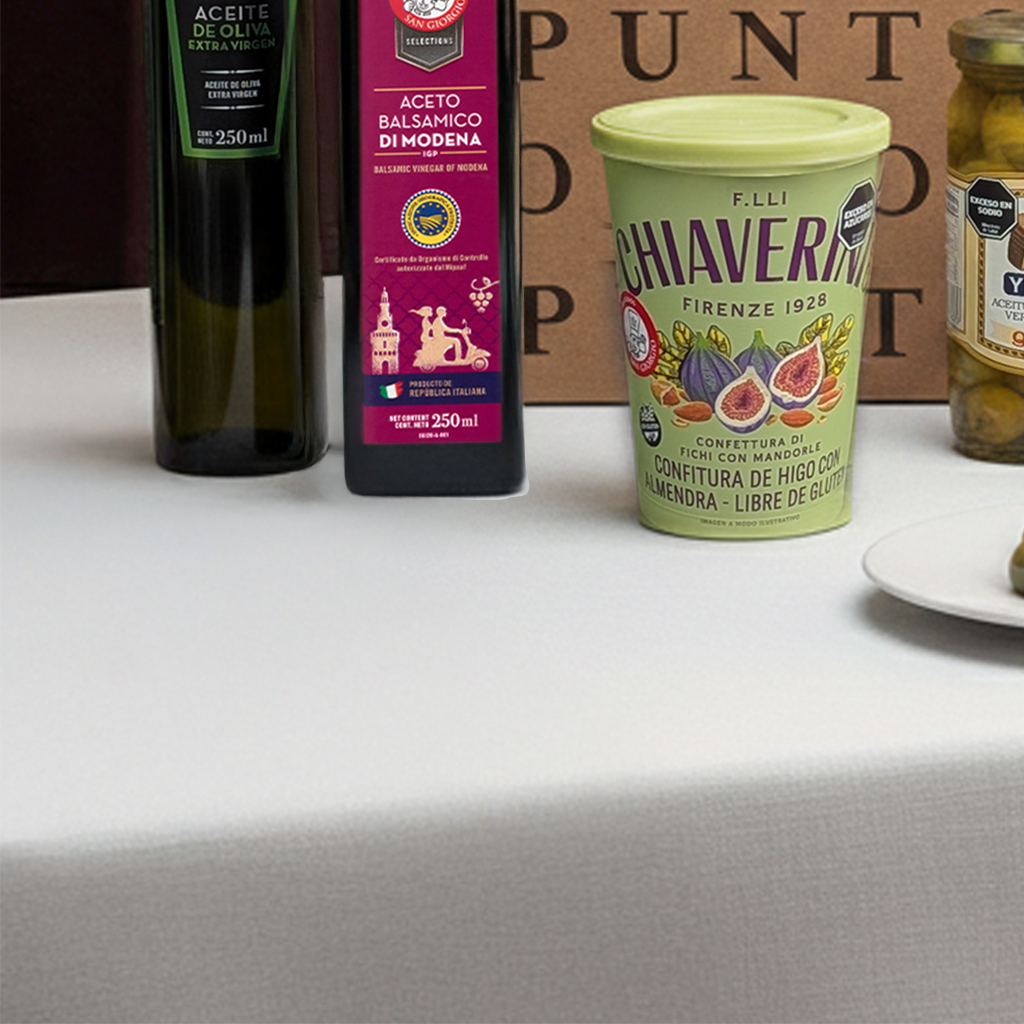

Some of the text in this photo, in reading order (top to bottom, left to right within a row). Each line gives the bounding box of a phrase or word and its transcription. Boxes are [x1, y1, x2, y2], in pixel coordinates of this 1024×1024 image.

[195, 4, 269, 21] ACEITE
[193, 22, 271, 38] DE OLIVA
[404, 14, 424, 29] SAN
[188, 38, 276, 51] EXTRA VIRGEN
[400, 93, 461, 110] ACETO
[378, 112, 483, 130] BALSAMICO
[215, 127, 268, 145] 250 ml
[379, 133, 482, 148] DI MODENA
[732, 191, 787, 207] F.LLI
[682, 292, 828, 317] FIRENZE 1928
[452, 387, 487, 396] ITALIANA
[431, 412, 478, 429] 250 ml
[696, 434, 803, 450] CONFETTURA DI
[680, 442, 821, 463] FICHI CON MANDORLE
[654, 446, 841, 489] CONFITURA DE HIGO CON
[645, 471, 718, 511] ALMENDRA
[735, 492, 782, 513] LIBRE
[787, 486, 806, 507] DE
